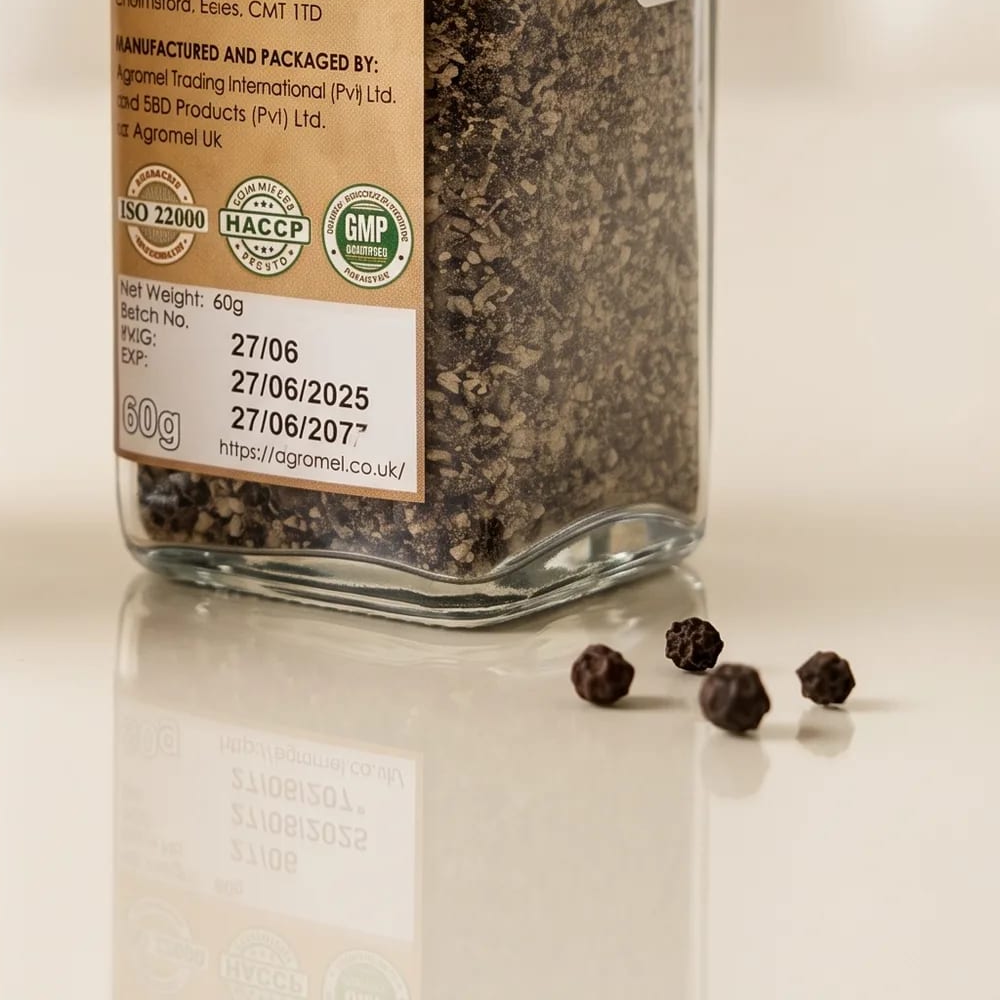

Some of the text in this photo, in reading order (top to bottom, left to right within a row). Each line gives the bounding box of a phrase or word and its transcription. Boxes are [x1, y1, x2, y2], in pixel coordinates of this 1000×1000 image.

[248, 0, 286, 19] CMT
[294, 3, 322, 21] 1TD
[116, 34, 379, 73] MANUFACTURED AND PACKAGED BY:
[116, 64, 168, 86] Agromel
[171, 69, 225, 95] Trading
[229, 75, 326, 99] International
[367, 85, 396, 104] Ltd.
[144, 95, 171, 115] 5BD
[176, 99, 246, 122] Products
[295, 109, 326, 129] Ltd.
[133, 122, 198, 146] Agromel
[203, 130, 223, 148] Uk
[120, 200, 205, 229] ISO 22000
[226, 214, 304, 239] HACCP
[345, 213, 388, 243] GMP
[120, 280, 243, 316] Net Weight: 60g
[164, 309, 189, 329] No.
[122, 346, 148, 367] EXP:
[231, 332, 299, 364] 27/06
[231, 369, 369, 411] 27/06/2025
[122, 395, 181, 451] 60g
[219, 439, 406, 480] https://agromel.co.uk/
